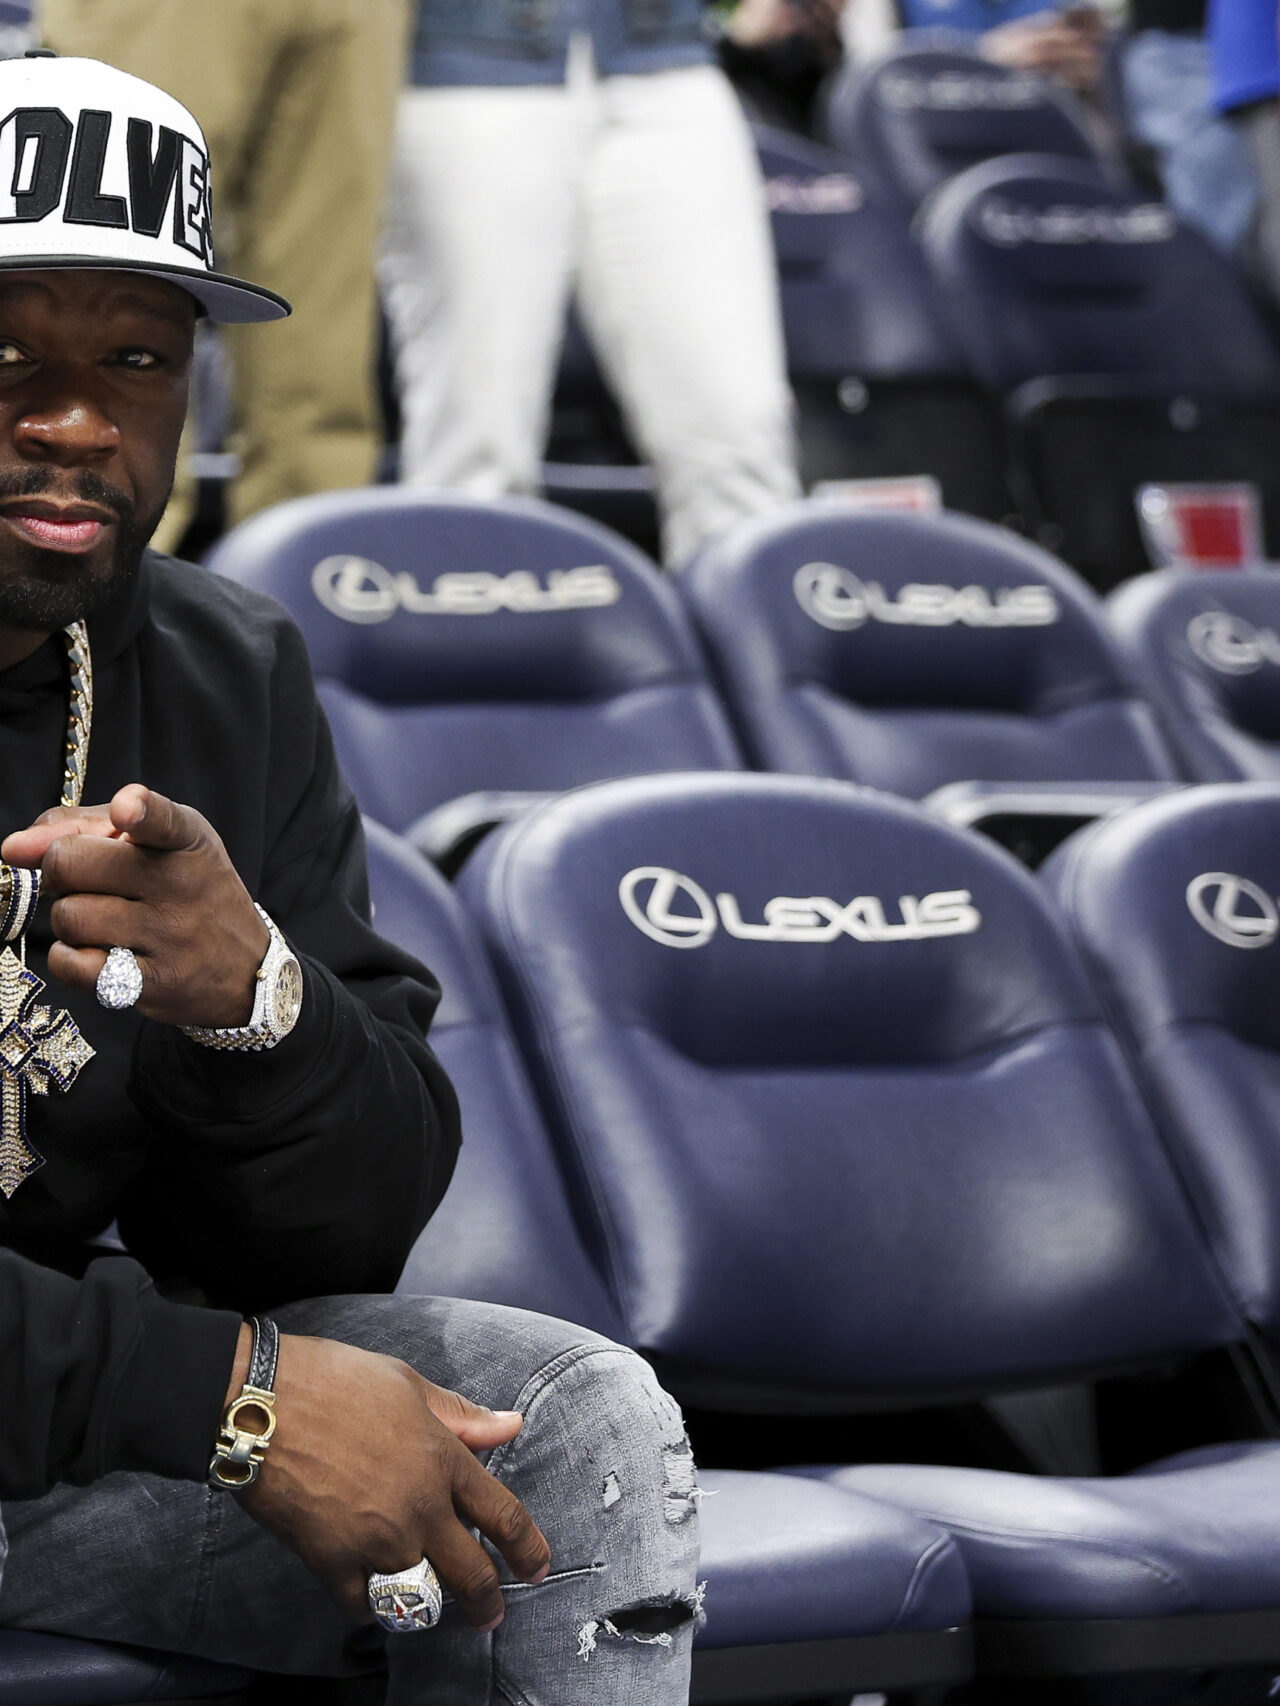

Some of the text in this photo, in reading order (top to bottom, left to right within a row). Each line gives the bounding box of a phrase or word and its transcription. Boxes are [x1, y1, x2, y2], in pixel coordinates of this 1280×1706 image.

[396, 564, 620, 614] LEXUS
[866, 581, 1060, 627] LEXUS
[716, 889, 982, 943] LEXUS
